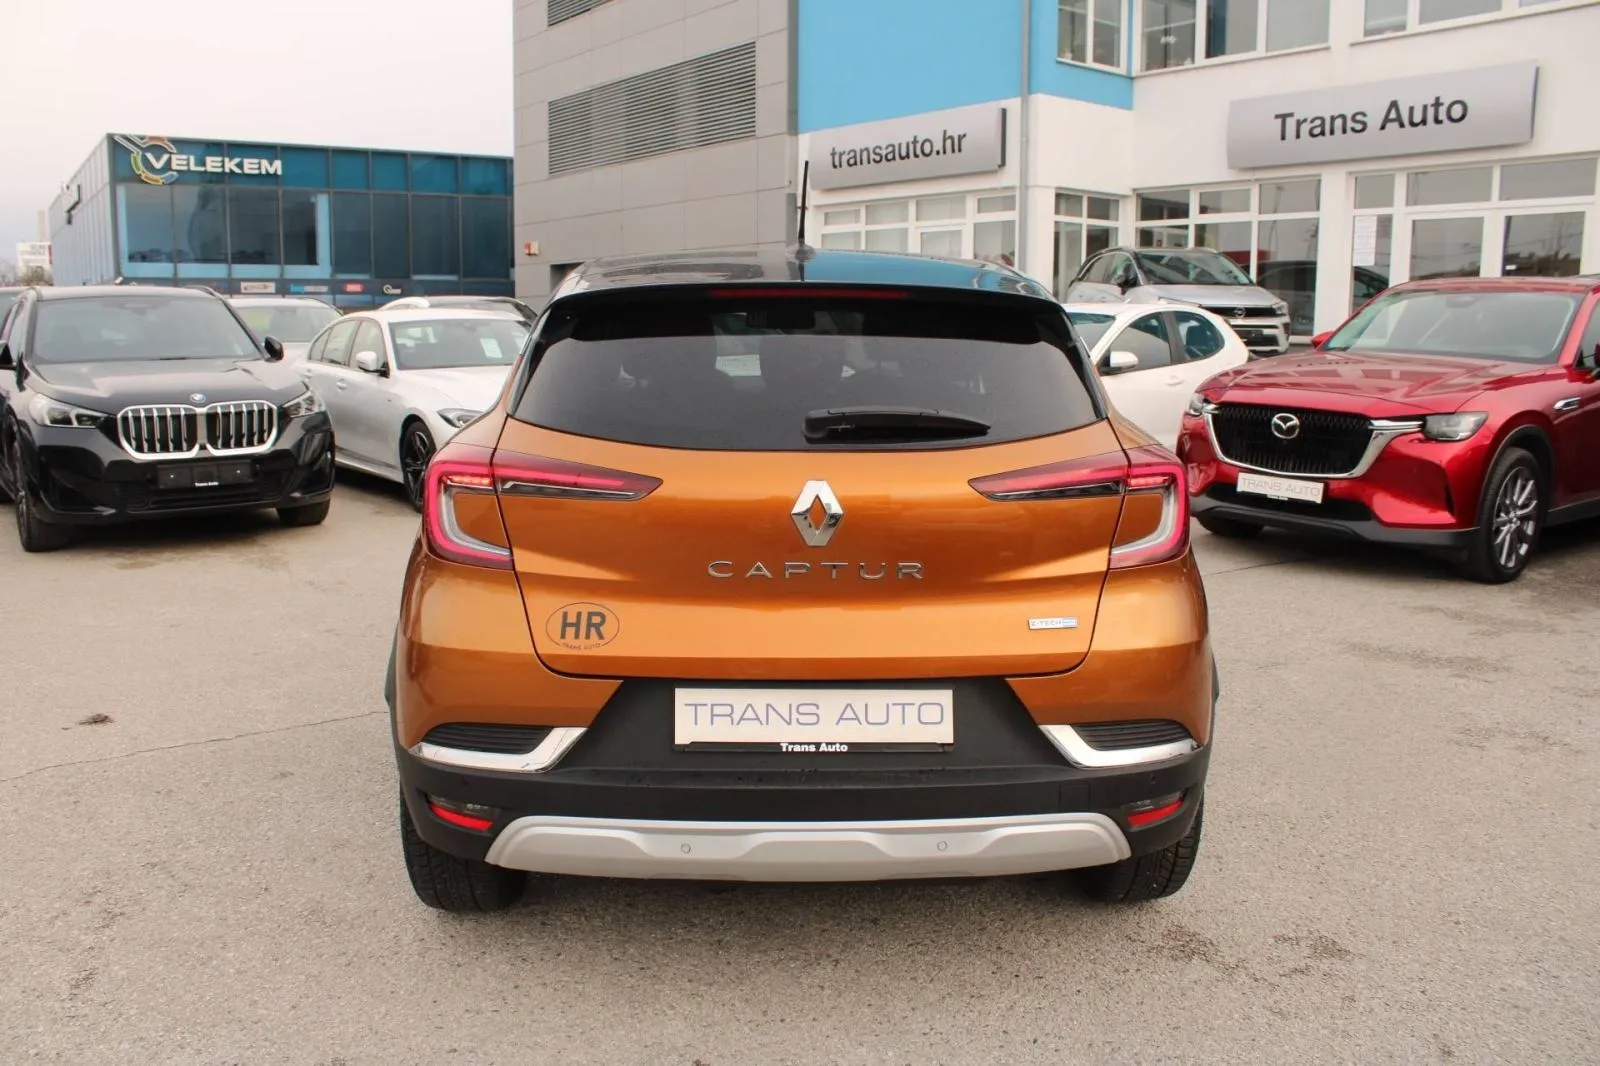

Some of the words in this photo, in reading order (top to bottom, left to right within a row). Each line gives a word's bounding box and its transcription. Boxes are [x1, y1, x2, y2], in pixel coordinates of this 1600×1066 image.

[1274, 112, 1368, 141] Trans
[1379, 96, 1468, 131] Auto
[830, 129, 967, 169] transauto.hr
[144, 152, 283, 175] VELEKEM
[1242, 478, 1281, 491] TRANS
[1285, 484, 1321, 497] AUTO
[707, 560, 924, 579] CAPTUR
[560, 611, 606, 640] HR
[684, 703, 820, 726] TRANS
[836, 703, 944, 726] AUTO
[780, 742, 816, 752] Trans
[819, 742, 848, 752] Auto
